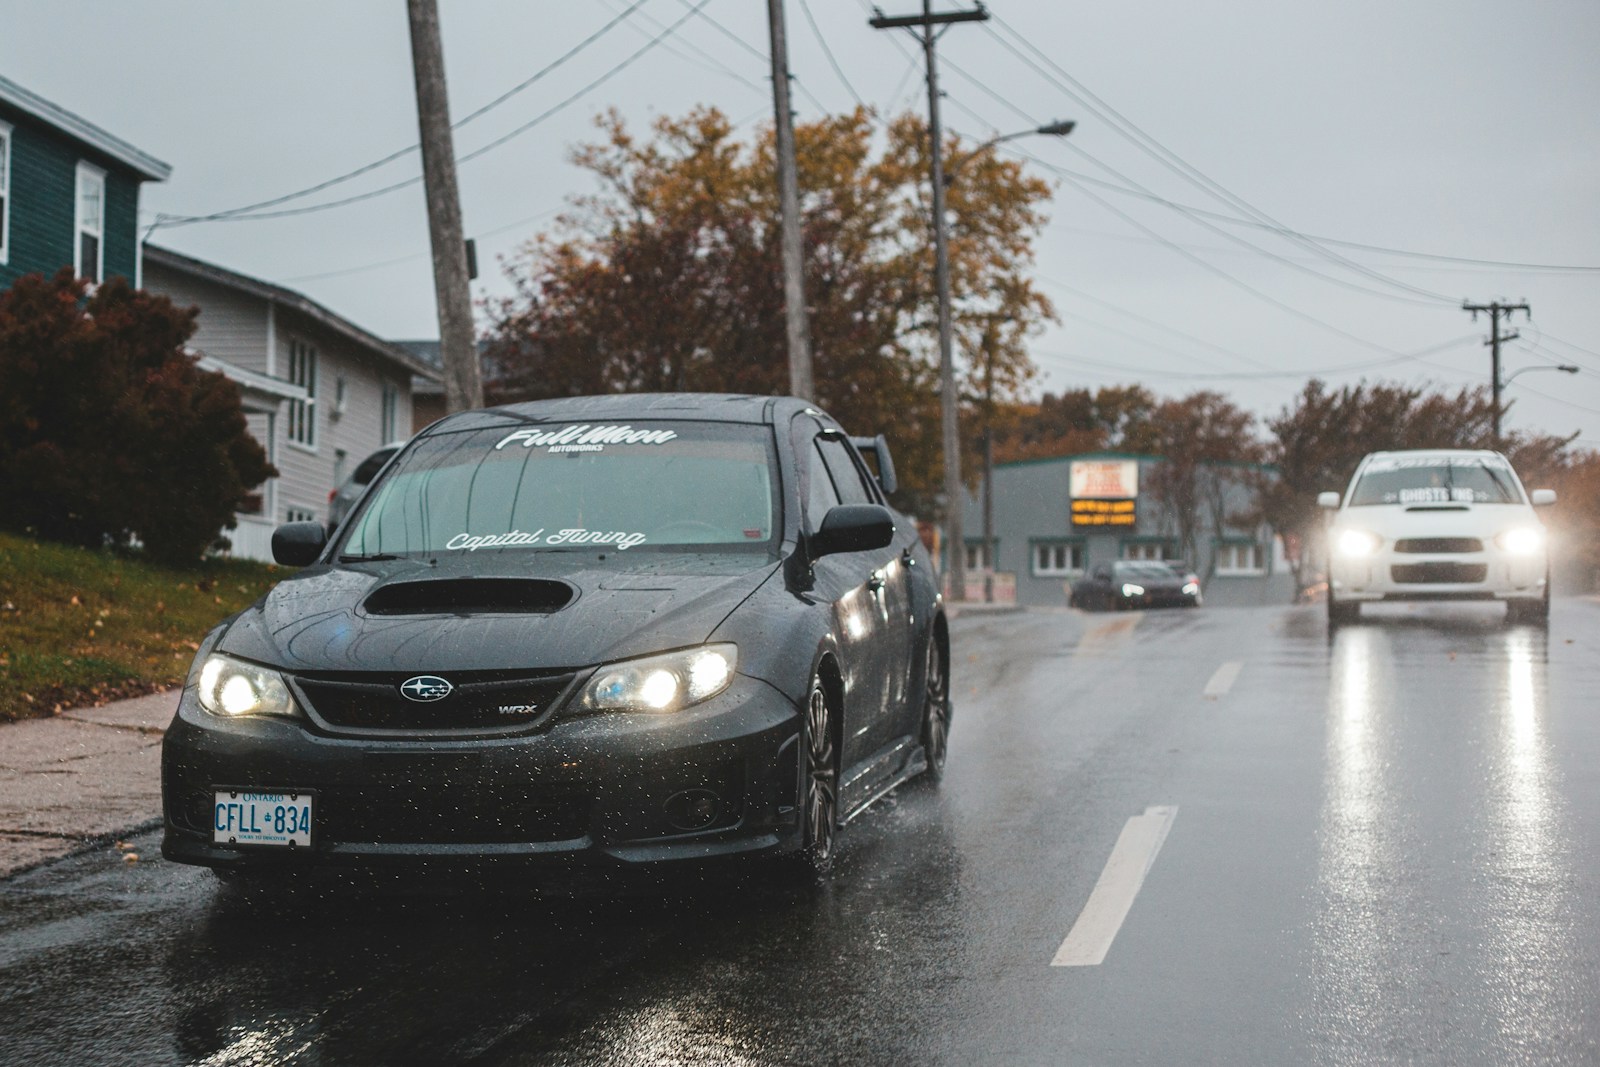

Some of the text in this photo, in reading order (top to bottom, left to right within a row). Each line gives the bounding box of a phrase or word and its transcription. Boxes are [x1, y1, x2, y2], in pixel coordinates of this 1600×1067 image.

[548, 444, 604, 453] AUTOWORKS
[446, 528, 647, 551] Capital Tuning
[498, 705, 537, 714] WRX
[242, 792, 284, 802] ONTARIO
[215, 803, 309, 834] CFLL 834
